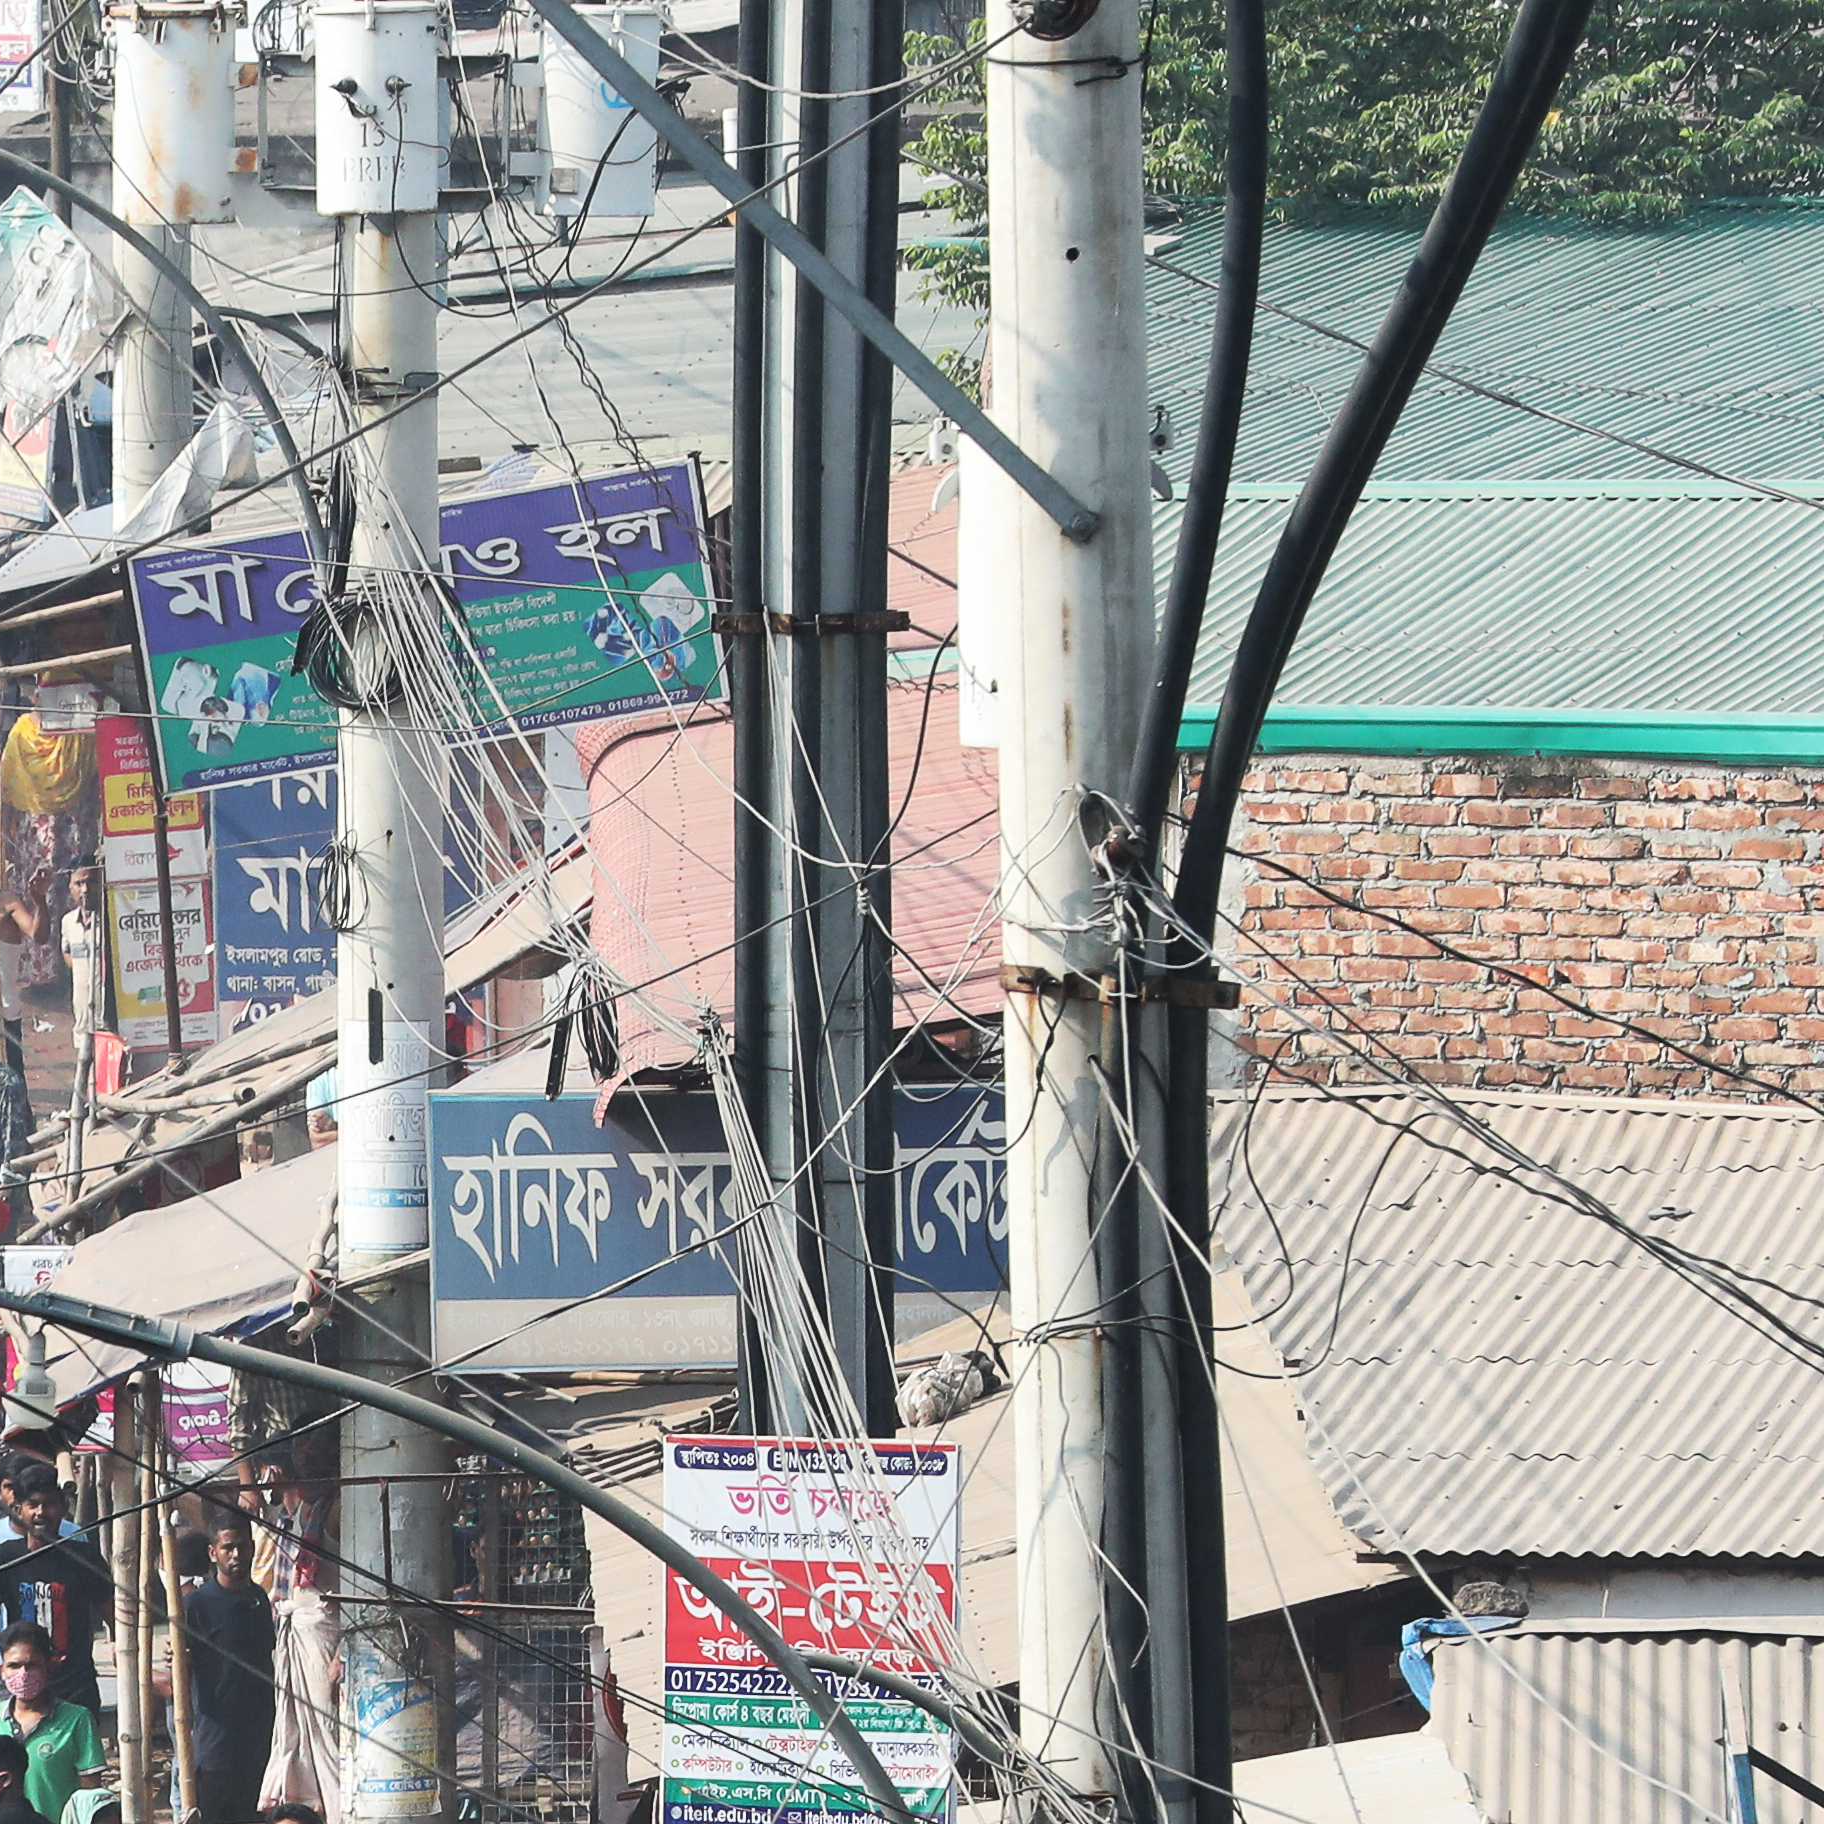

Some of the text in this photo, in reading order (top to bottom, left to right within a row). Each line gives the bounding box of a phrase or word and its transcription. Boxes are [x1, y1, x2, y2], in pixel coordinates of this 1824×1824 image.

[147, 555, 263, 626] মা
[225, 944, 289, 968] ইসলামপুর
[293, 947, 327, 968] রোড,
[262, 975, 301, 993] বাসন,
[442, 1112, 619, 1284] হানিফ
[723, 1451, 755, 1467] ২০০৪
[726, 1474, 799, 1518] ভর্তি
[682, 1756, 732, 1774] কম্পিউটার
